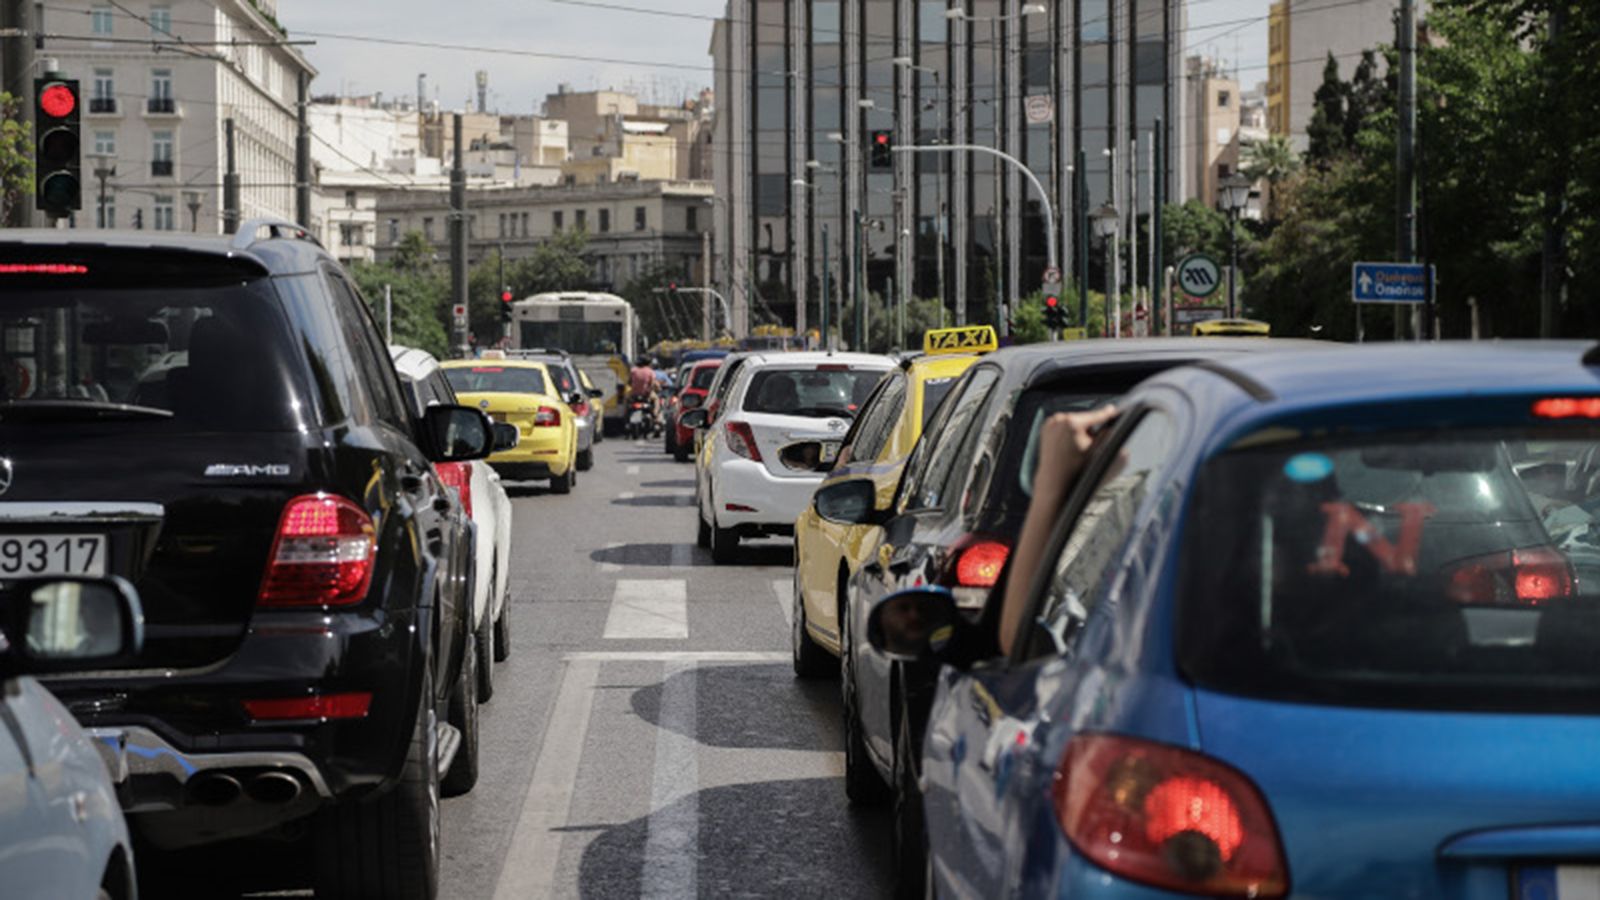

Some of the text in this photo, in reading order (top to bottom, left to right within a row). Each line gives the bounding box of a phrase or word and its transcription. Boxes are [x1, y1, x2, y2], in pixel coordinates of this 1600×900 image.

[929, 329, 989, 348] TAXI
[232, 464, 290, 476] AMG
[1306, 501, 1438, 577] N
[1, 538, 99, 573] 9317
